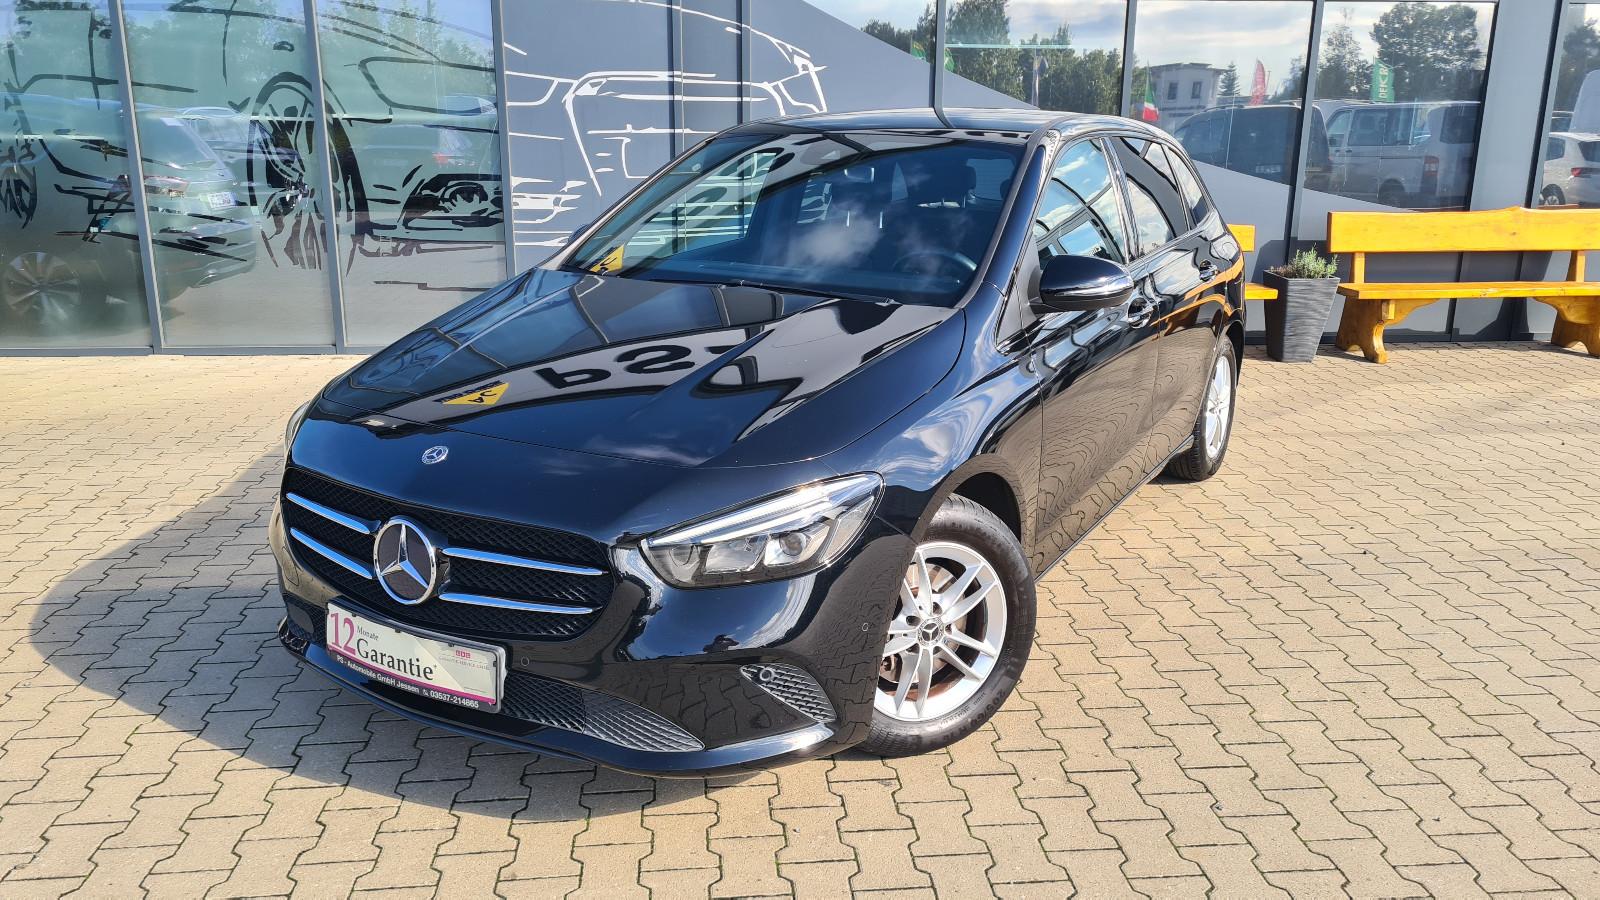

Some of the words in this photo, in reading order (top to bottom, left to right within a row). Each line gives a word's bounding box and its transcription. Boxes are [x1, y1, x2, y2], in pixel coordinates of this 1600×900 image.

[330, 612, 356, 655] 12
[347, 660, 376, 679] Automobile
[377, 673, 396, 686] GmbH
[397, 680, 420, 693] Jessen
